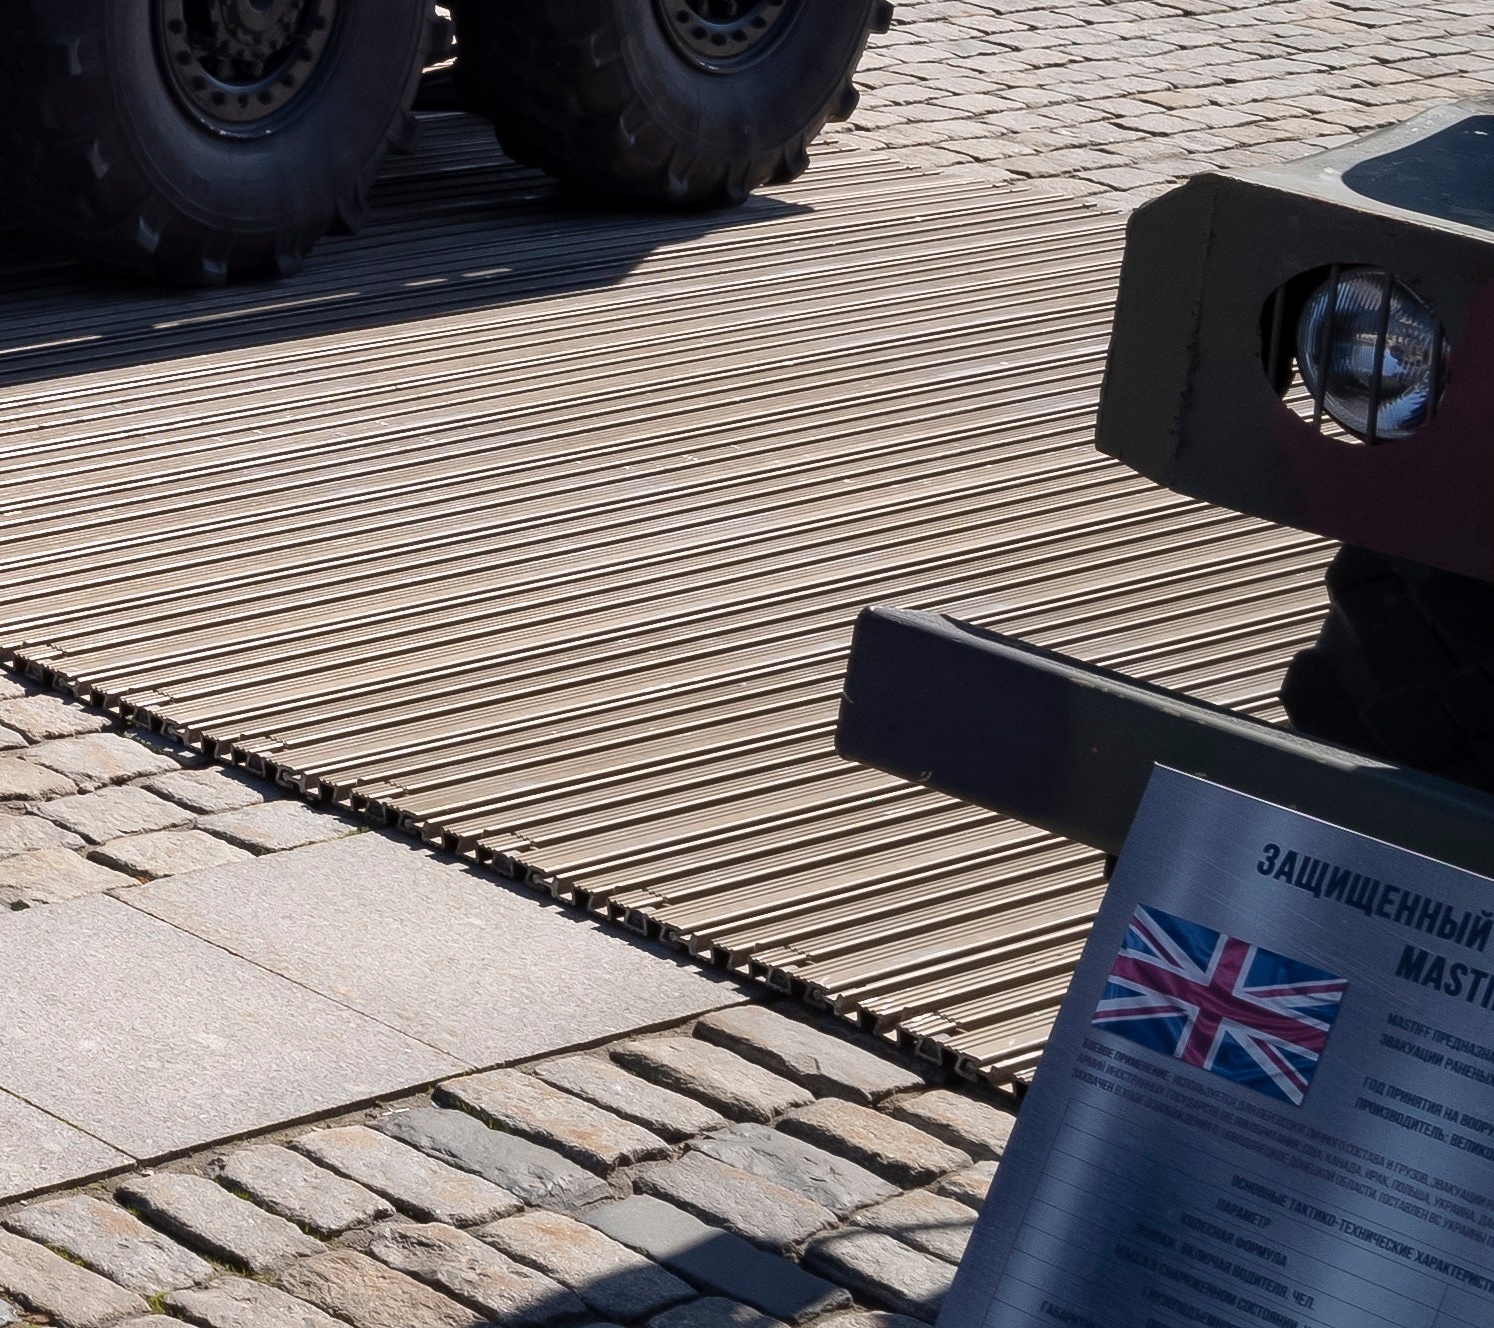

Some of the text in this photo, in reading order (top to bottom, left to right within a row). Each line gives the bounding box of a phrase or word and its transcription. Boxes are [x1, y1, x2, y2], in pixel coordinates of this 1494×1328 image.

[1256, 843, 1494, 953] ЗАЩИЩЕННЫЙ
[1394, 945, 1494, 1012] MASTI
[1378, 1032, 1444, 1068] ЭВАКУАЦИИ
[1387, 1012, 1431, 1038] MASTIFF
[1354, 1096, 1494, 1162] ПРОИЗВОДИТЕЛЬ: ВЕЛИКО
[1362, 1076, 1494, 1138] ГОД ПРИНЯТИЯ НА ВООРУ
[1346, 1142, 1386, 1168] СОСТАВА
[1179, 1211, 1289, 1269] КОЛЕСНАЯ ФОРМУЛА
[1215, 1197, 1272, 1230] ПАРАМЕТР
[1289, 1197, 1416, 1261] ТАКТИКО-ТЕХНИЧЕСКИЕ
[1291, 1288, 1317, 1312] ЧЕЛ.
